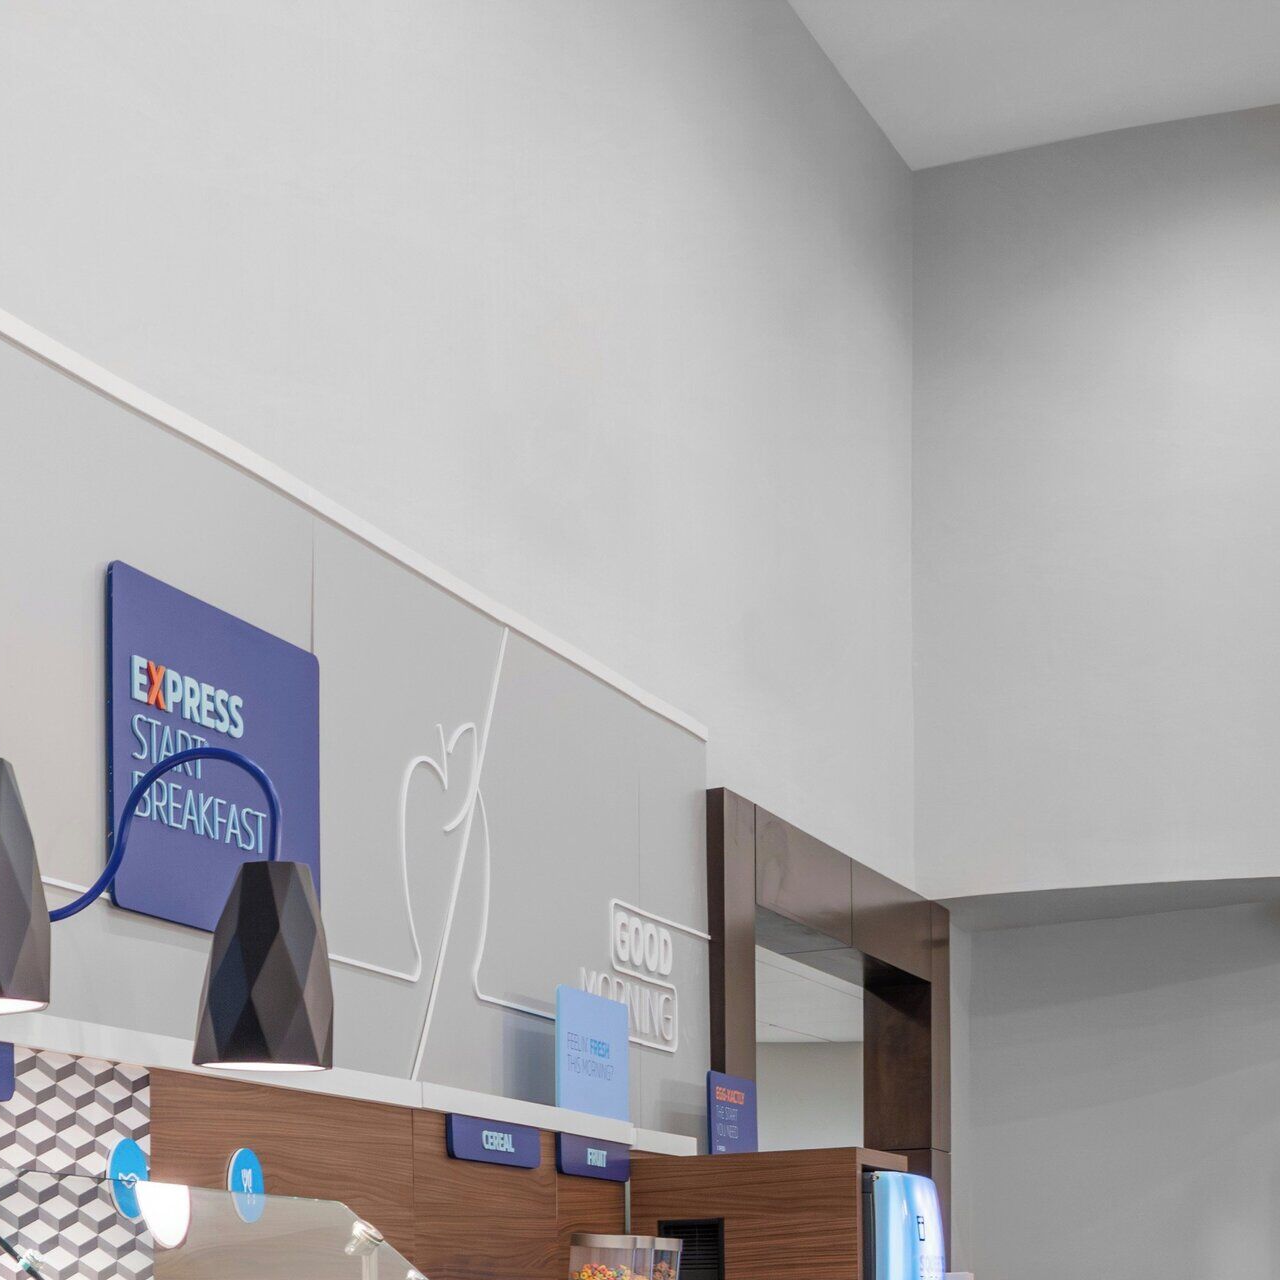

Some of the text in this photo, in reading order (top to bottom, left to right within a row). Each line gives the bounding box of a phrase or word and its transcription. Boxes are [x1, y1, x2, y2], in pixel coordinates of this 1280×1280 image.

[131, 654, 244, 739] EXPRESS
[131, 713, 206, 780] START
[131, 770, 267, 854] BREAKFAST
[615, 911, 673, 976] GOOD
[482, 1130, 515, 1153] CEREAL
[586, 1147, 607, 1168] FRUIT
